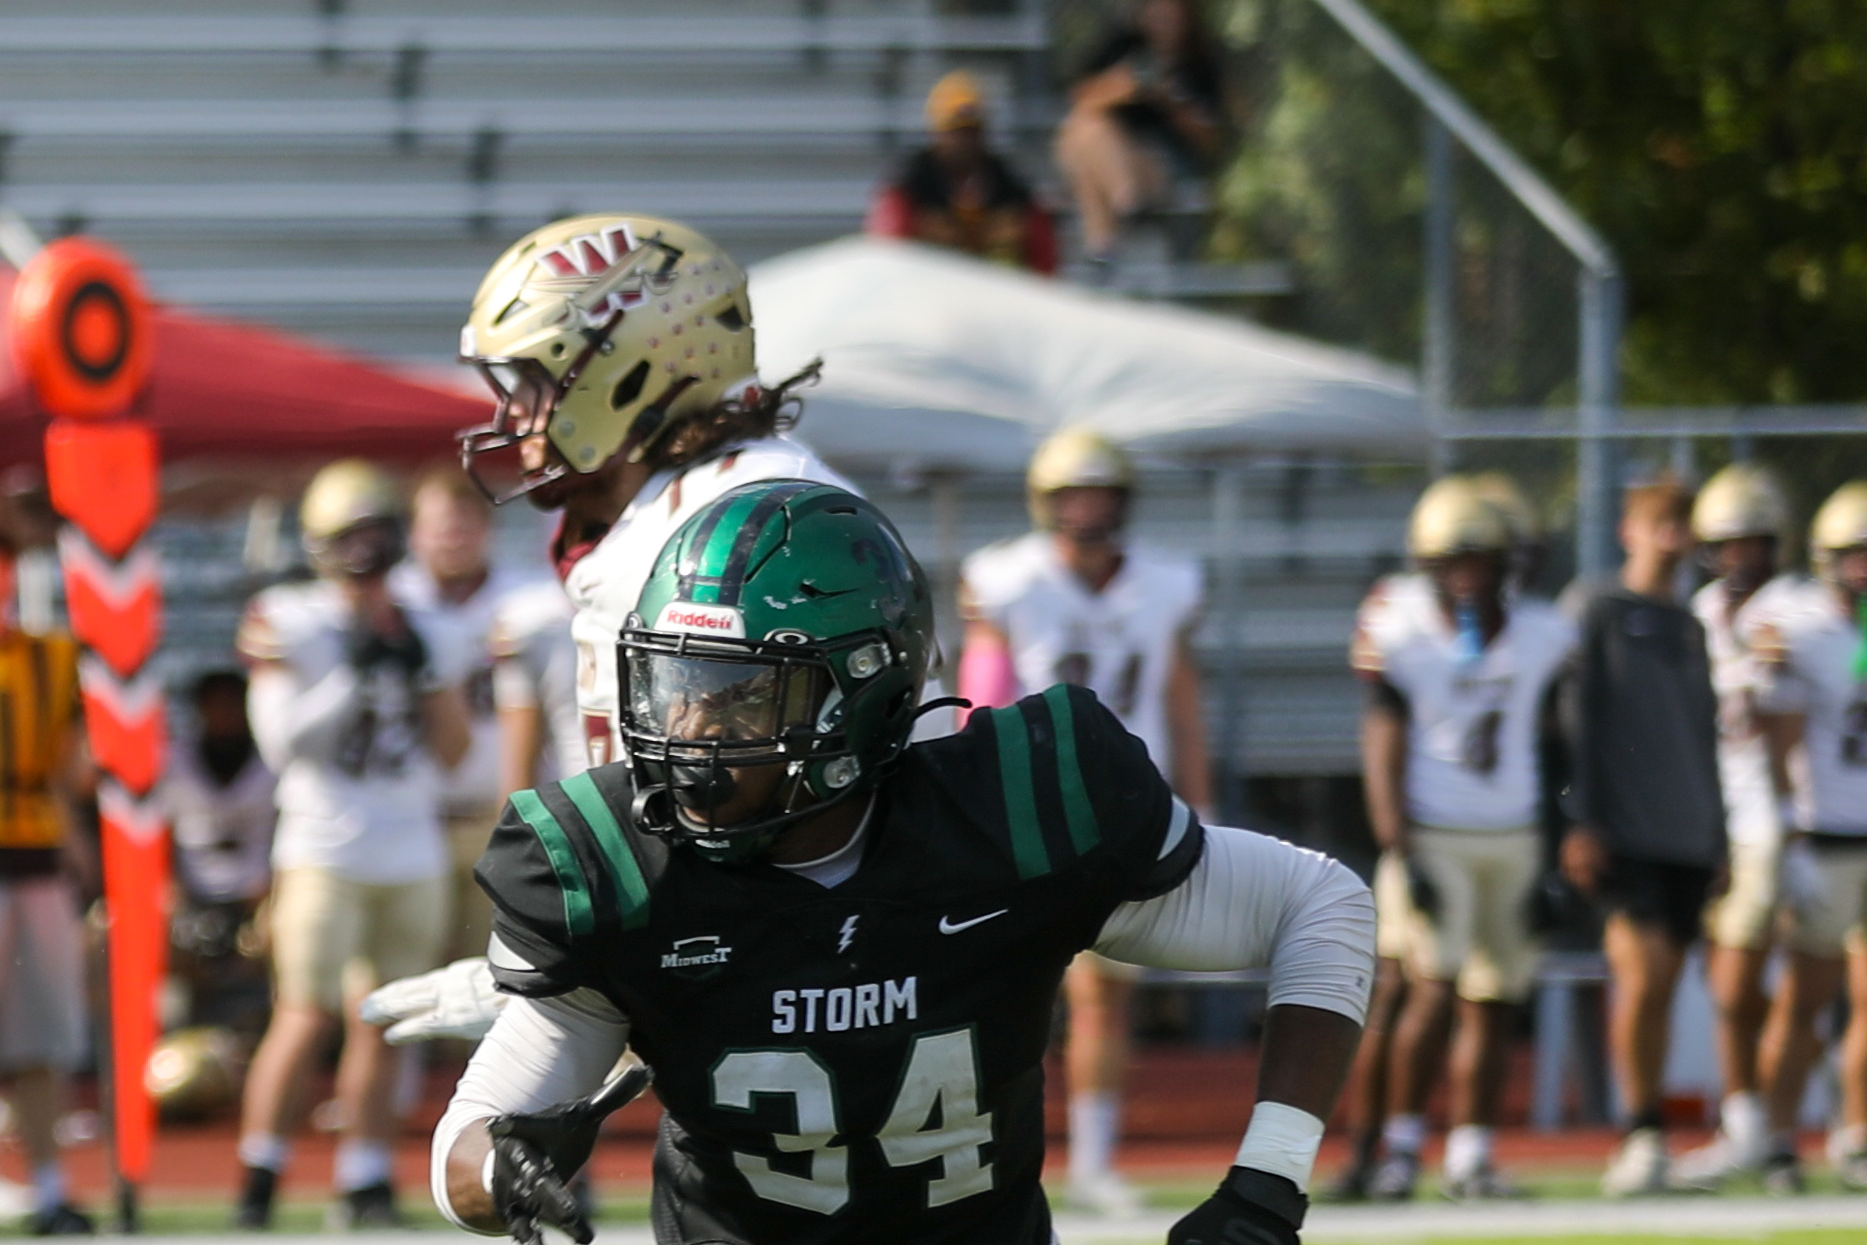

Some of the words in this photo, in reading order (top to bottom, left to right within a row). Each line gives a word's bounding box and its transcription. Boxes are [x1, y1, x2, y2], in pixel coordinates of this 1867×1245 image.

[667, 609, 735, 630] Riddell
[771, 976, 919, 1034] STORM
[709, 1025, 996, 1216] 34
